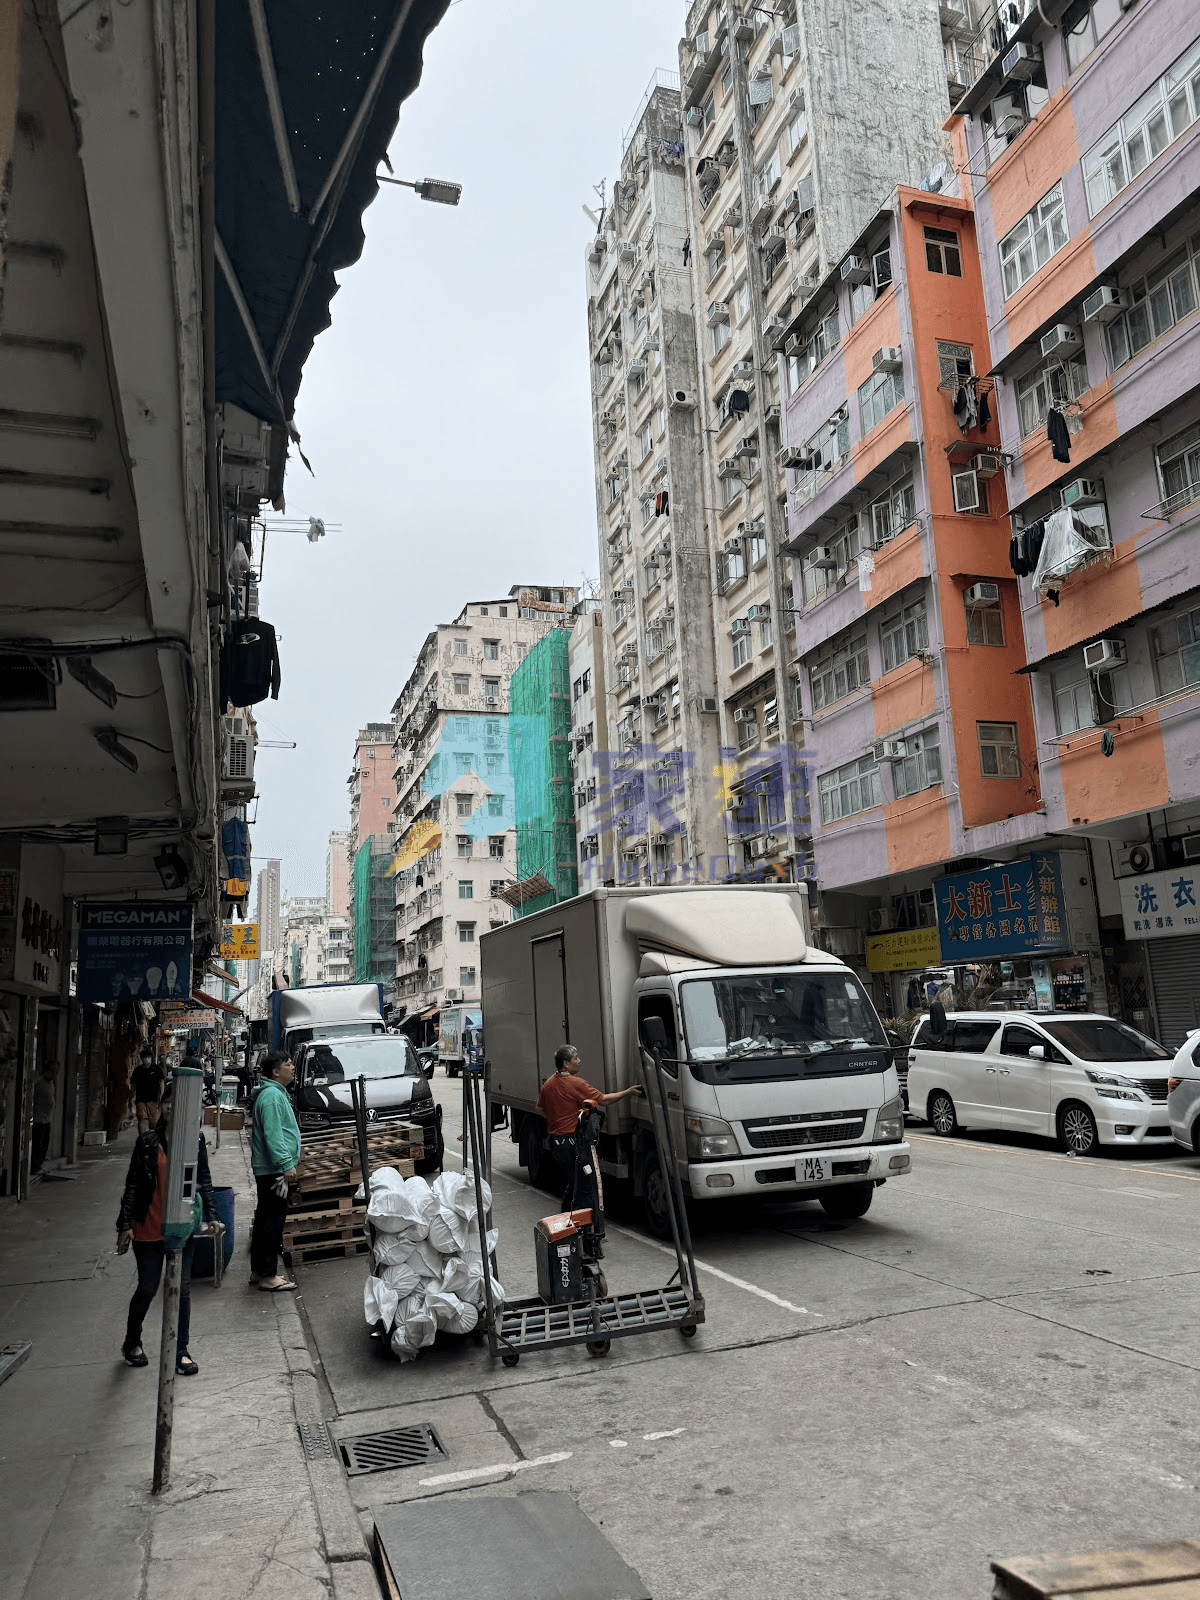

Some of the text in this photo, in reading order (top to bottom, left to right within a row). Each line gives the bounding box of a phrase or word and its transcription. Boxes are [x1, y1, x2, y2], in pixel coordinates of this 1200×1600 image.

[1036, 857, 1061, 933] 大新辦館
[1134, 876, 1196, 913] 洗衣
[848, 1060, 878, 1068] CANTER
[768, 1112, 844, 1124] FUSO
[805, 1158, 822, 1170] MA
[803, 1169, 824, 1180] 145
